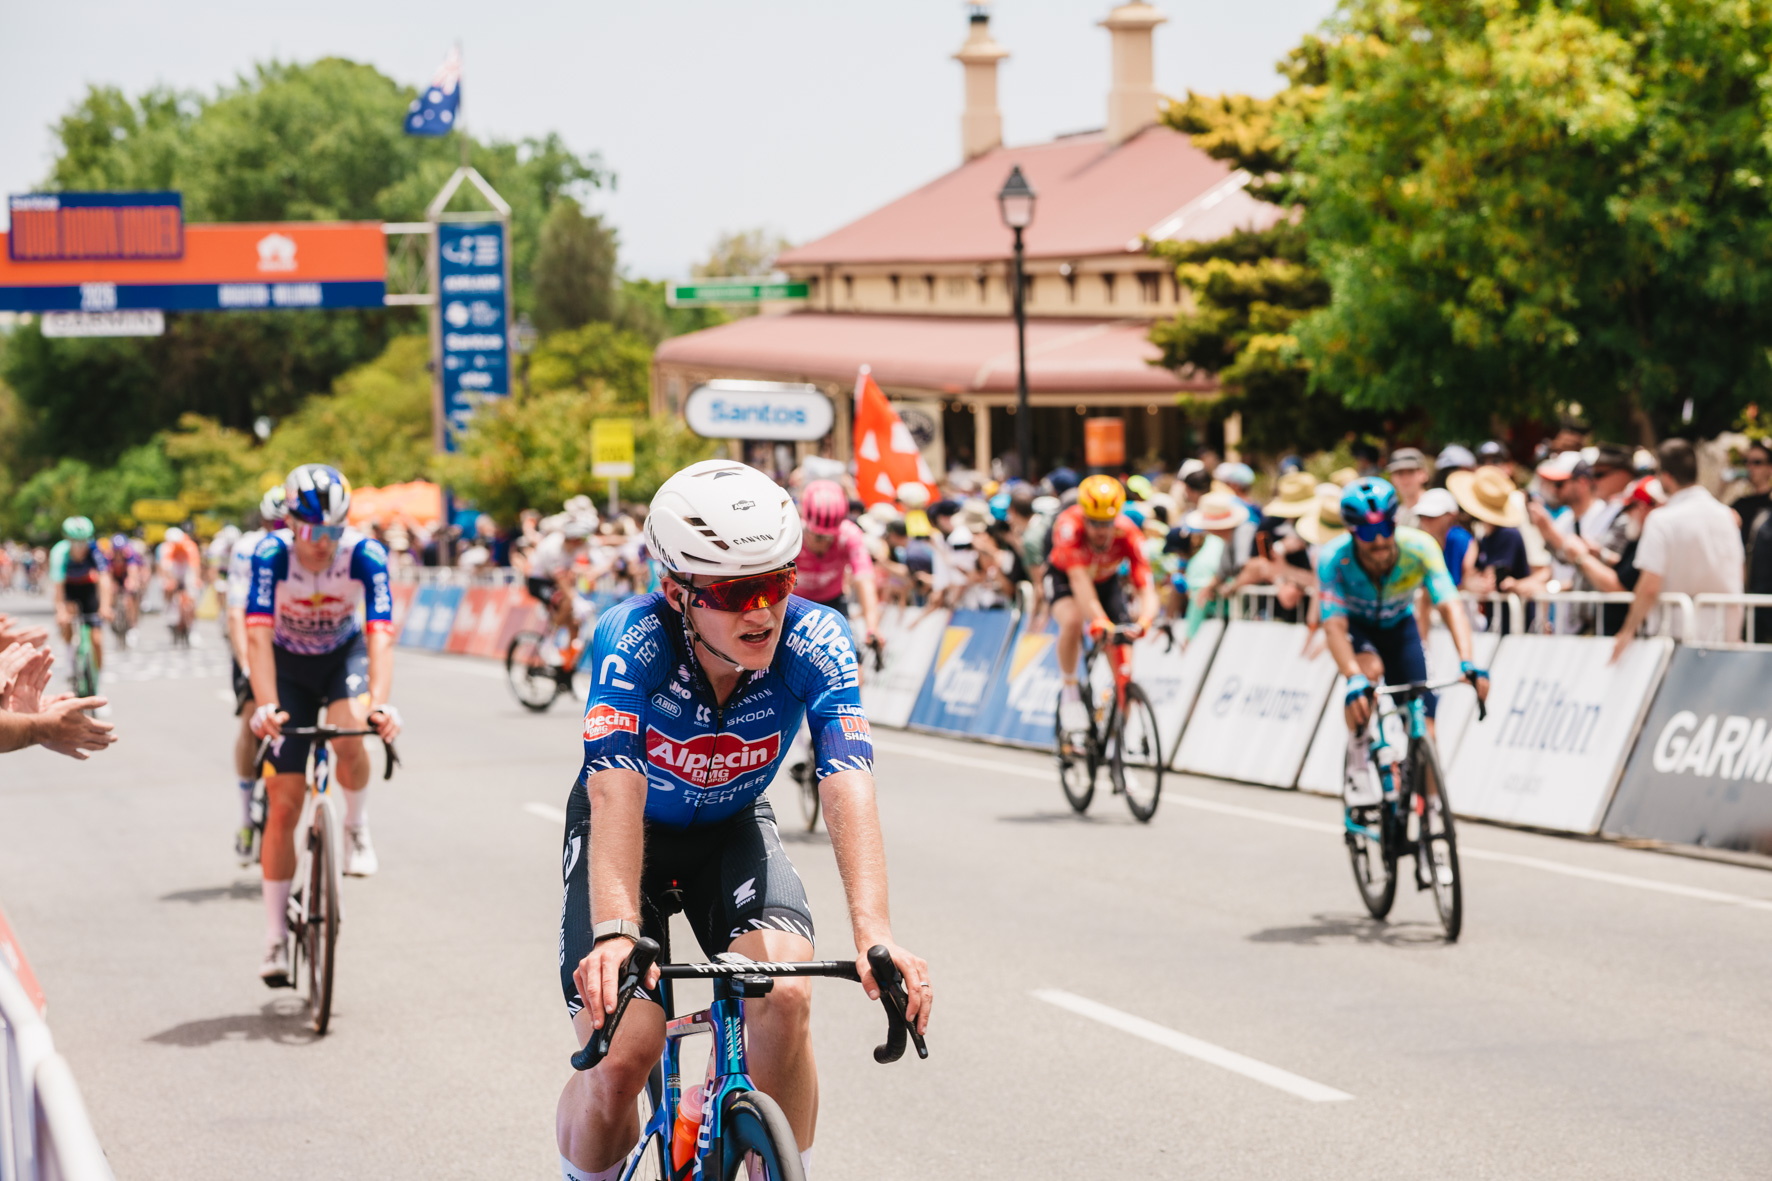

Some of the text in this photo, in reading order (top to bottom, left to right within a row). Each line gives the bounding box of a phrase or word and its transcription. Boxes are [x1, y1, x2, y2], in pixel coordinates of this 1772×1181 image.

[710, 399, 806, 424] Santos
[733, 534, 774, 545] CANYON
[616, 613, 662, 654] PREMIER
[786, 632, 810, 657] DMG
[793, 609, 859, 688] Alpecin
[634, 637, 660, 667] TECH
[655, 697, 679, 714] ABUS
[1495, 678, 1600, 755] Hilton
[840, 716, 871, 734] DM
[648, 741, 768, 773] Alpecin
[1653, 710, 1772, 784] GARM
[684, 774, 768, 799] PREMIER
[692, 768, 730, 779] DMG
[724, 1016, 735, 1061] CANYON
[733, 1016, 743, 1060] CANYON
